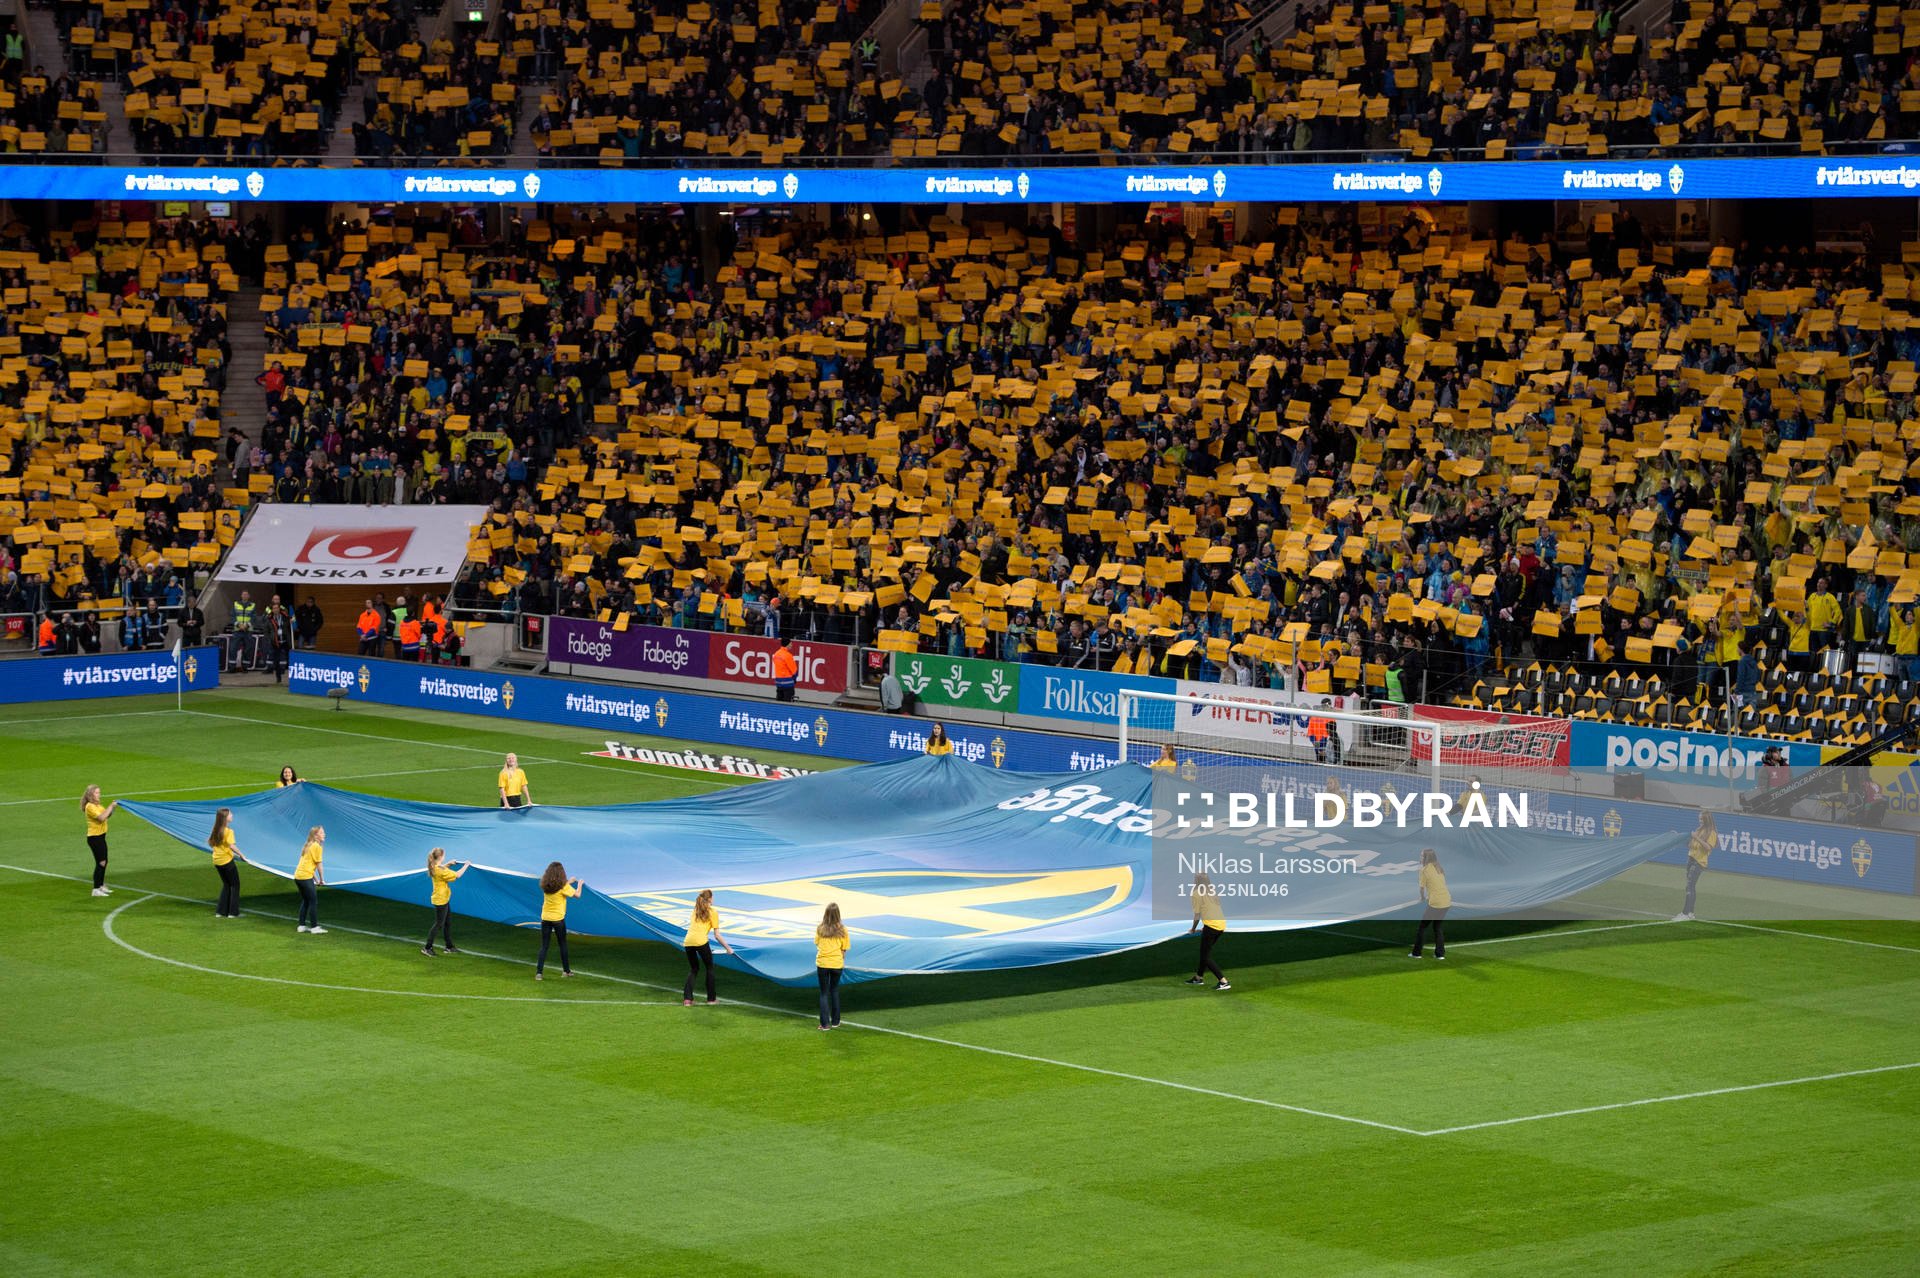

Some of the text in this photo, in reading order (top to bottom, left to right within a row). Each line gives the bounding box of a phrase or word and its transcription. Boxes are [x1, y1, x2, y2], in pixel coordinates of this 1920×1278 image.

[125, 174, 239, 194] #viärsverige
[404, 176, 516, 195] #viärsverige
[678, 176, 776, 195] #viärsverige
[925, 177, 1013, 195] #viärsverige
[1126, 174, 1208, 194] #viärsverige
[1333, 172, 1423, 192] #viärsverige
[1563, 169, 1661, 191] #viärsverige
[231, 564, 449, 578] SVENSKA SPEL
[8, 618, 23, 629] 107
[568, 632, 612, 662] Fabege
[643, 640, 688, 671] Fabege
[63, 662, 178, 686] #viärsverige
[725, 641, 825, 685] Scadic
[911, 660, 922, 677] SJ
[951, 664, 962, 681] SJ
[991, 668, 1003, 685] SJ
[420, 676, 498, 705] #viärsverige
[1043, 677, 1139, 720] Folksam
[566, 693, 650, 722] #viärsverige
[1212, 693, 1329, 729] INTERSPO
[719, 710, 809, 742] #viärsverige
[889, 730, 985, 762] #viärerige
[1606, 735, 1790, 781] postnor
[604, 740, 720, 771] Framåt
[721, 757, 771, 777] för
[1717, 830, 1842, 870] viärsverige
